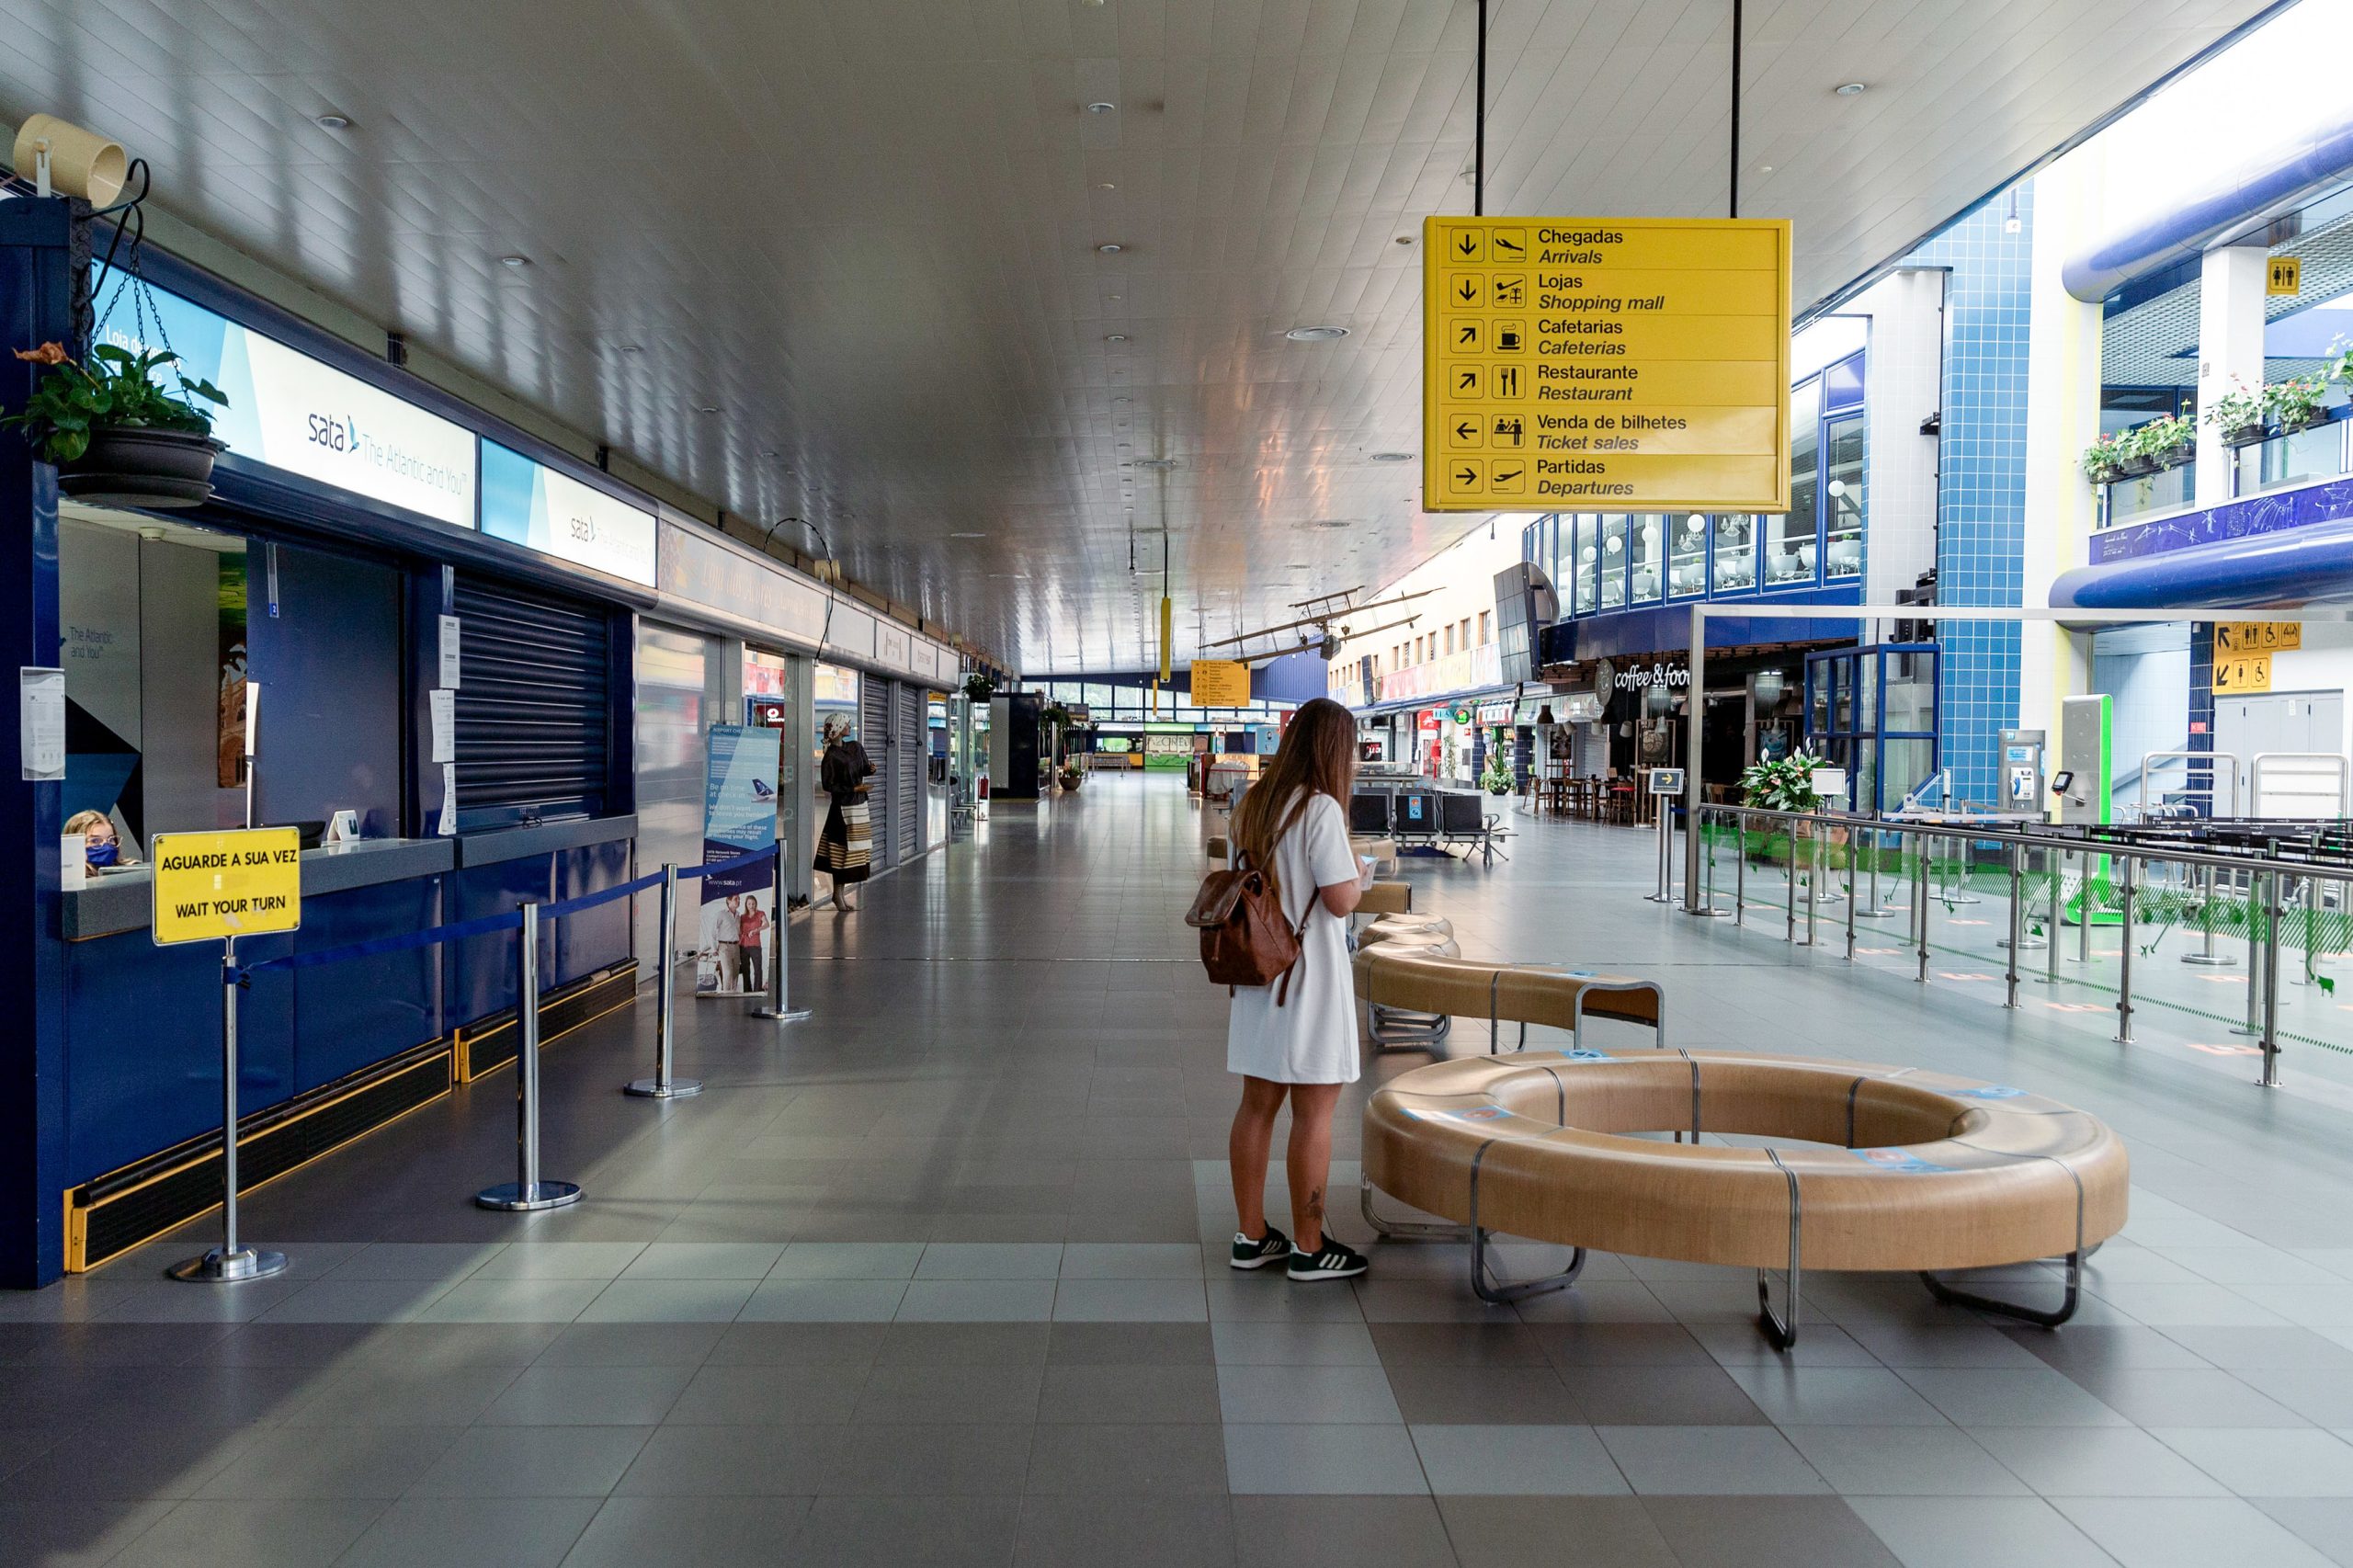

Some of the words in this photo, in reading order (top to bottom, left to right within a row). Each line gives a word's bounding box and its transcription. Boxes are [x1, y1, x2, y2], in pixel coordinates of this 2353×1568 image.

[1538, 229, 1623, 245] Chegadas
[1538, 249, 1603, 265] Arrivals
[1538, 274, 1584, 291] Lojas
[1538, 294, 1621, 313] Shopping
[1627, 295, 1665, 311] mall
[1538, 319, 1623, 335] Cafetarias
[1538, 339, 1626, 356] Cafeterias
[1538, 365, 1639, 381] Restaurante
[1538, 386, 1633, 401] Restaurant
[1537, 414, 1588, 430] Venda
[1594, 414, 1616, 430] de
[1620, 414, 1687, 430] bilhetes
[1537, 435, 1588, 450] Ticket
[1594, 435, 1639, 450] sales
[309, 413, 345, 451] sata
[362, 433, 383, 467] The
[386, 444, 425, 483] Atlantic
[426, 465, 443, 489] and
[1537, 459, 1606, 474] Partidas
[1537, 480, 1634, 497] Departures
[571, 517, 589, 543] sata
[69, 626, 85, 642] The
[71, 646, 85, 658] and
[1615, 665, 1653, 691] coffee
[1654, 663, 1664, 685] &
[1665, 663, 1690, 691] foo
[161, 853, 227, 871] AGUARDE
[231, 853, 241, 867] A
[244, 851, 269, 866] SUA
[273, 849, 297, 863] VEZ
[176, 902, 209, 918] WAIT
[212, 899, 248, 915] YOUR
[251, 895, 286, 911] TURN
